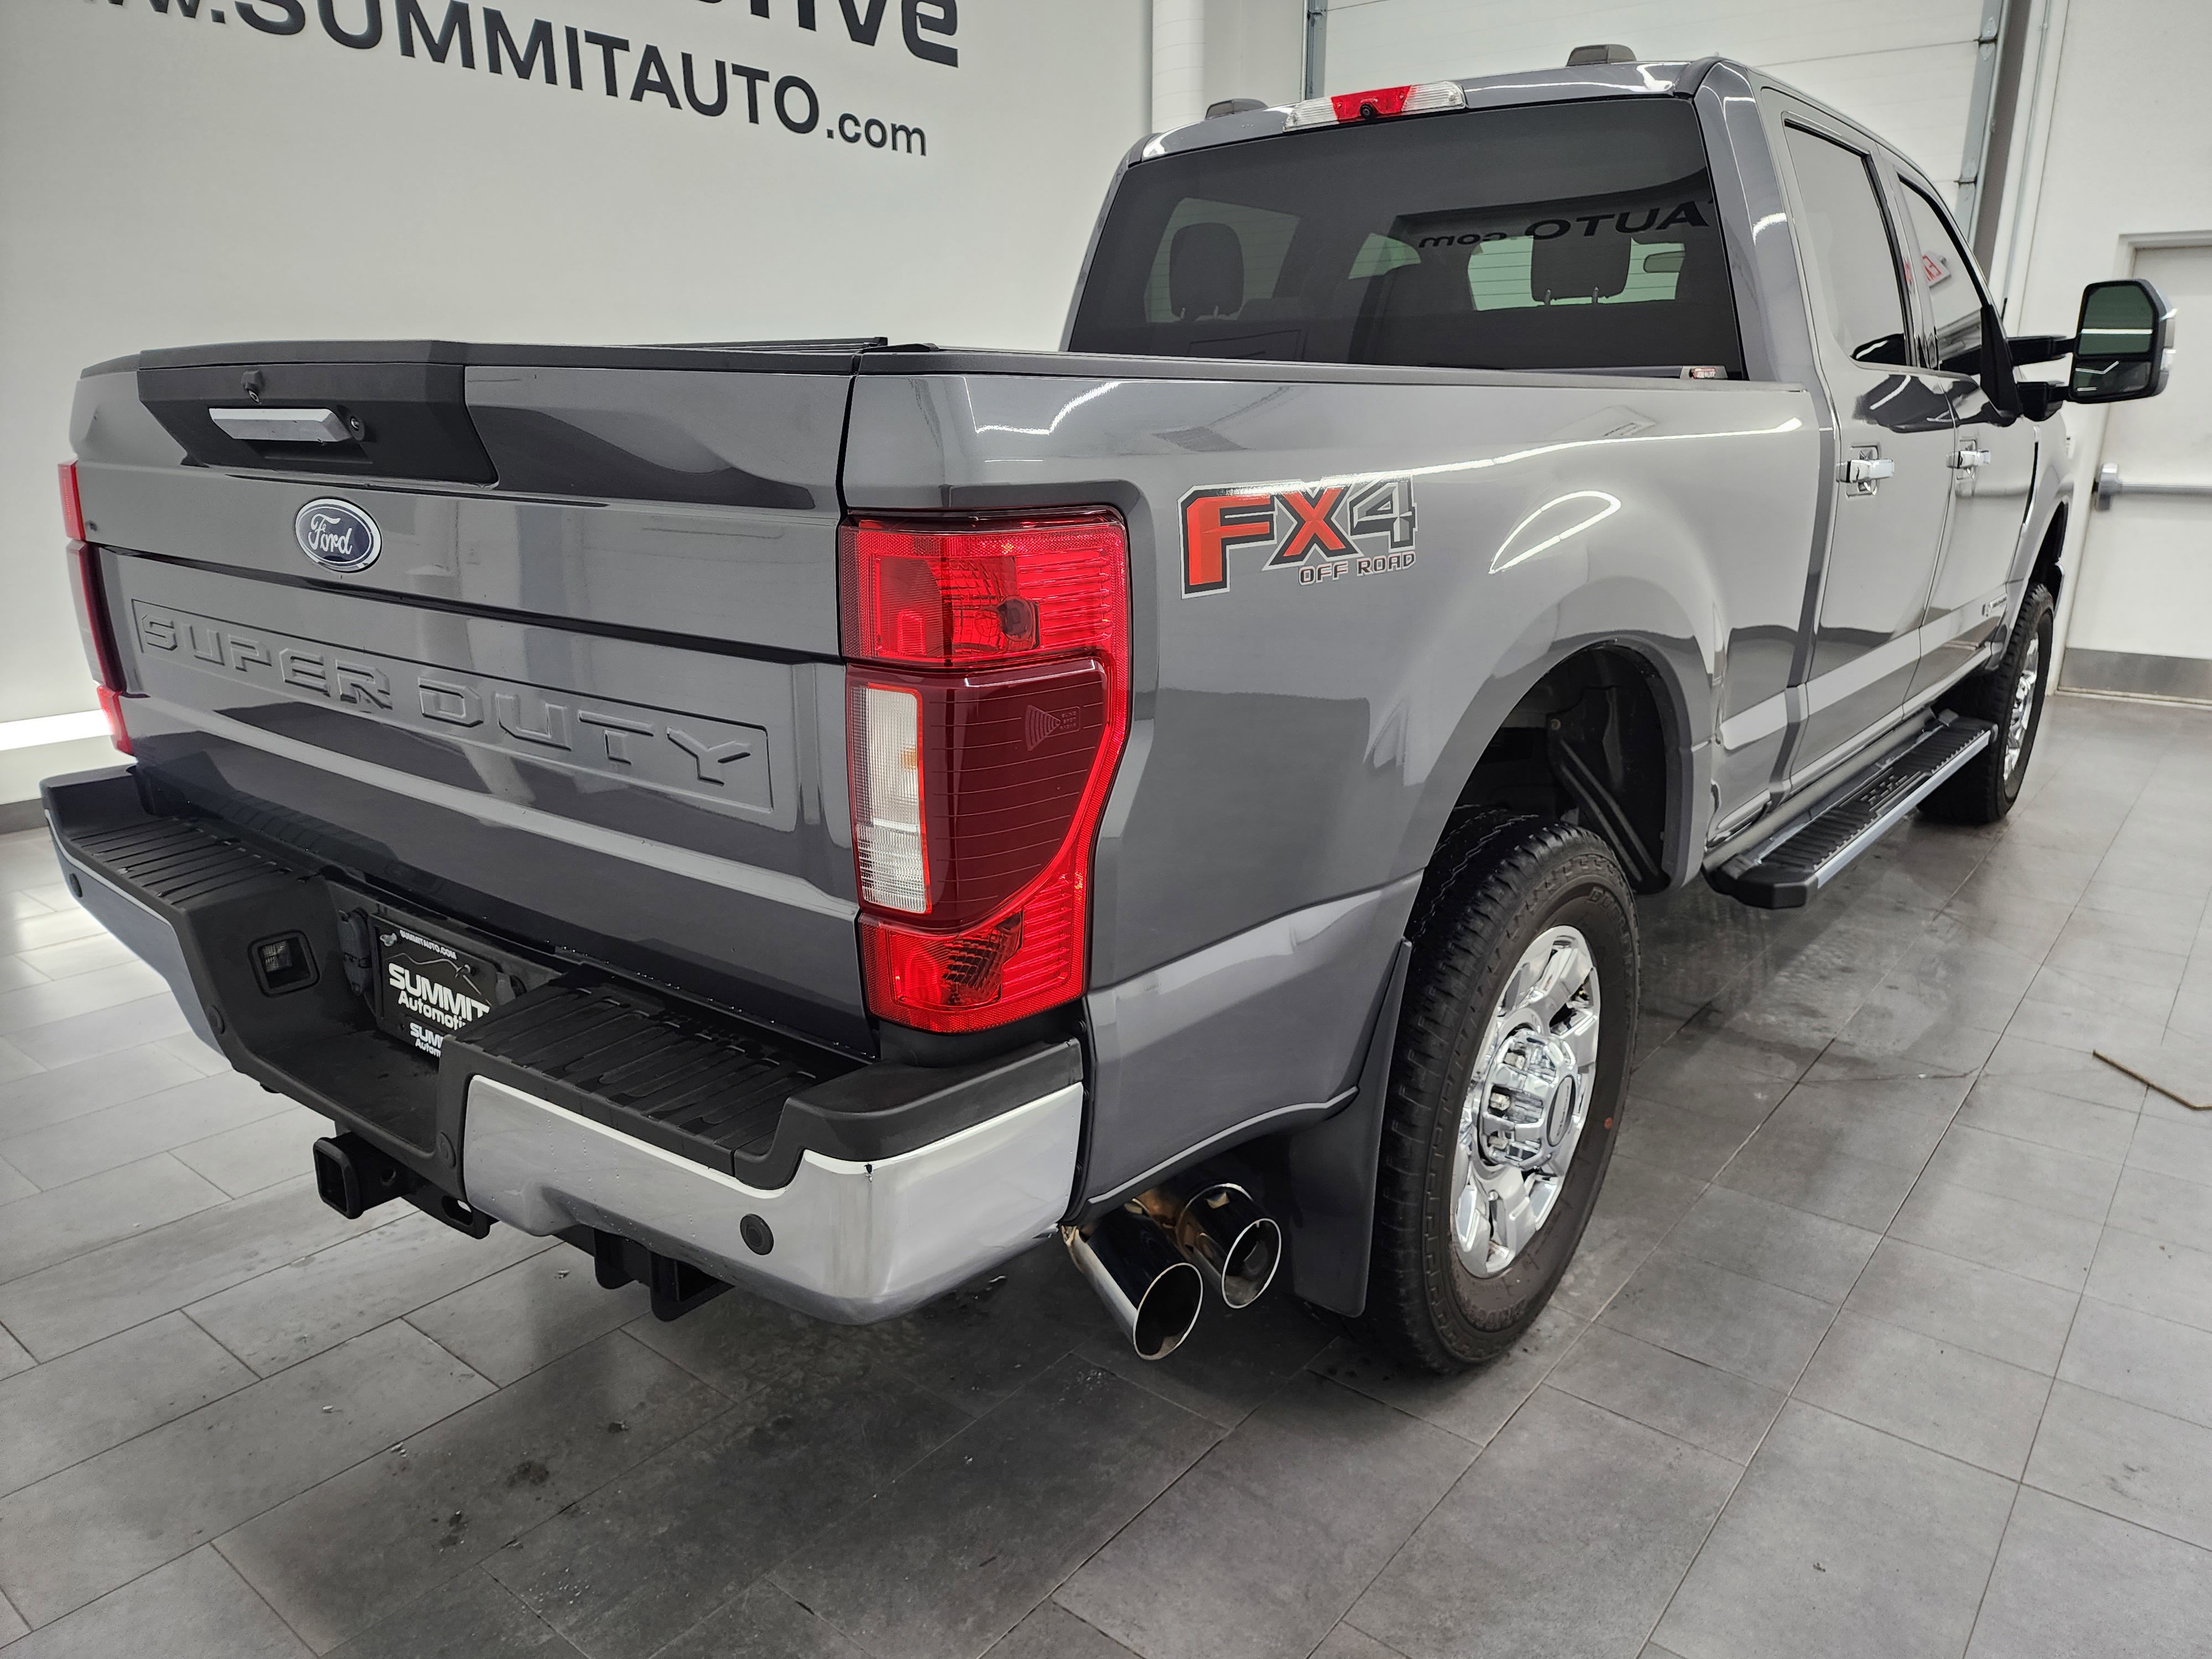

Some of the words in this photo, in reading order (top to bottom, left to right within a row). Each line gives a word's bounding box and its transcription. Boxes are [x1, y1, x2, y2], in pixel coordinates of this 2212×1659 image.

[307, 513, 353, 555] Ford
[1177, 472, 1418, 600] FX4
[1298, 561, 1349, 587] OFF
[1357, 551, 1416, 577] ROAD
[141, 613, 393, 711] SUPER
[418, 676, 753, 787] DUTY
[399, 930, 457, 960] SUMMITAUTO.COM
[388, 963, 491, 1022] SUMMIT
[398, 990, 466, 1031] Automoti
